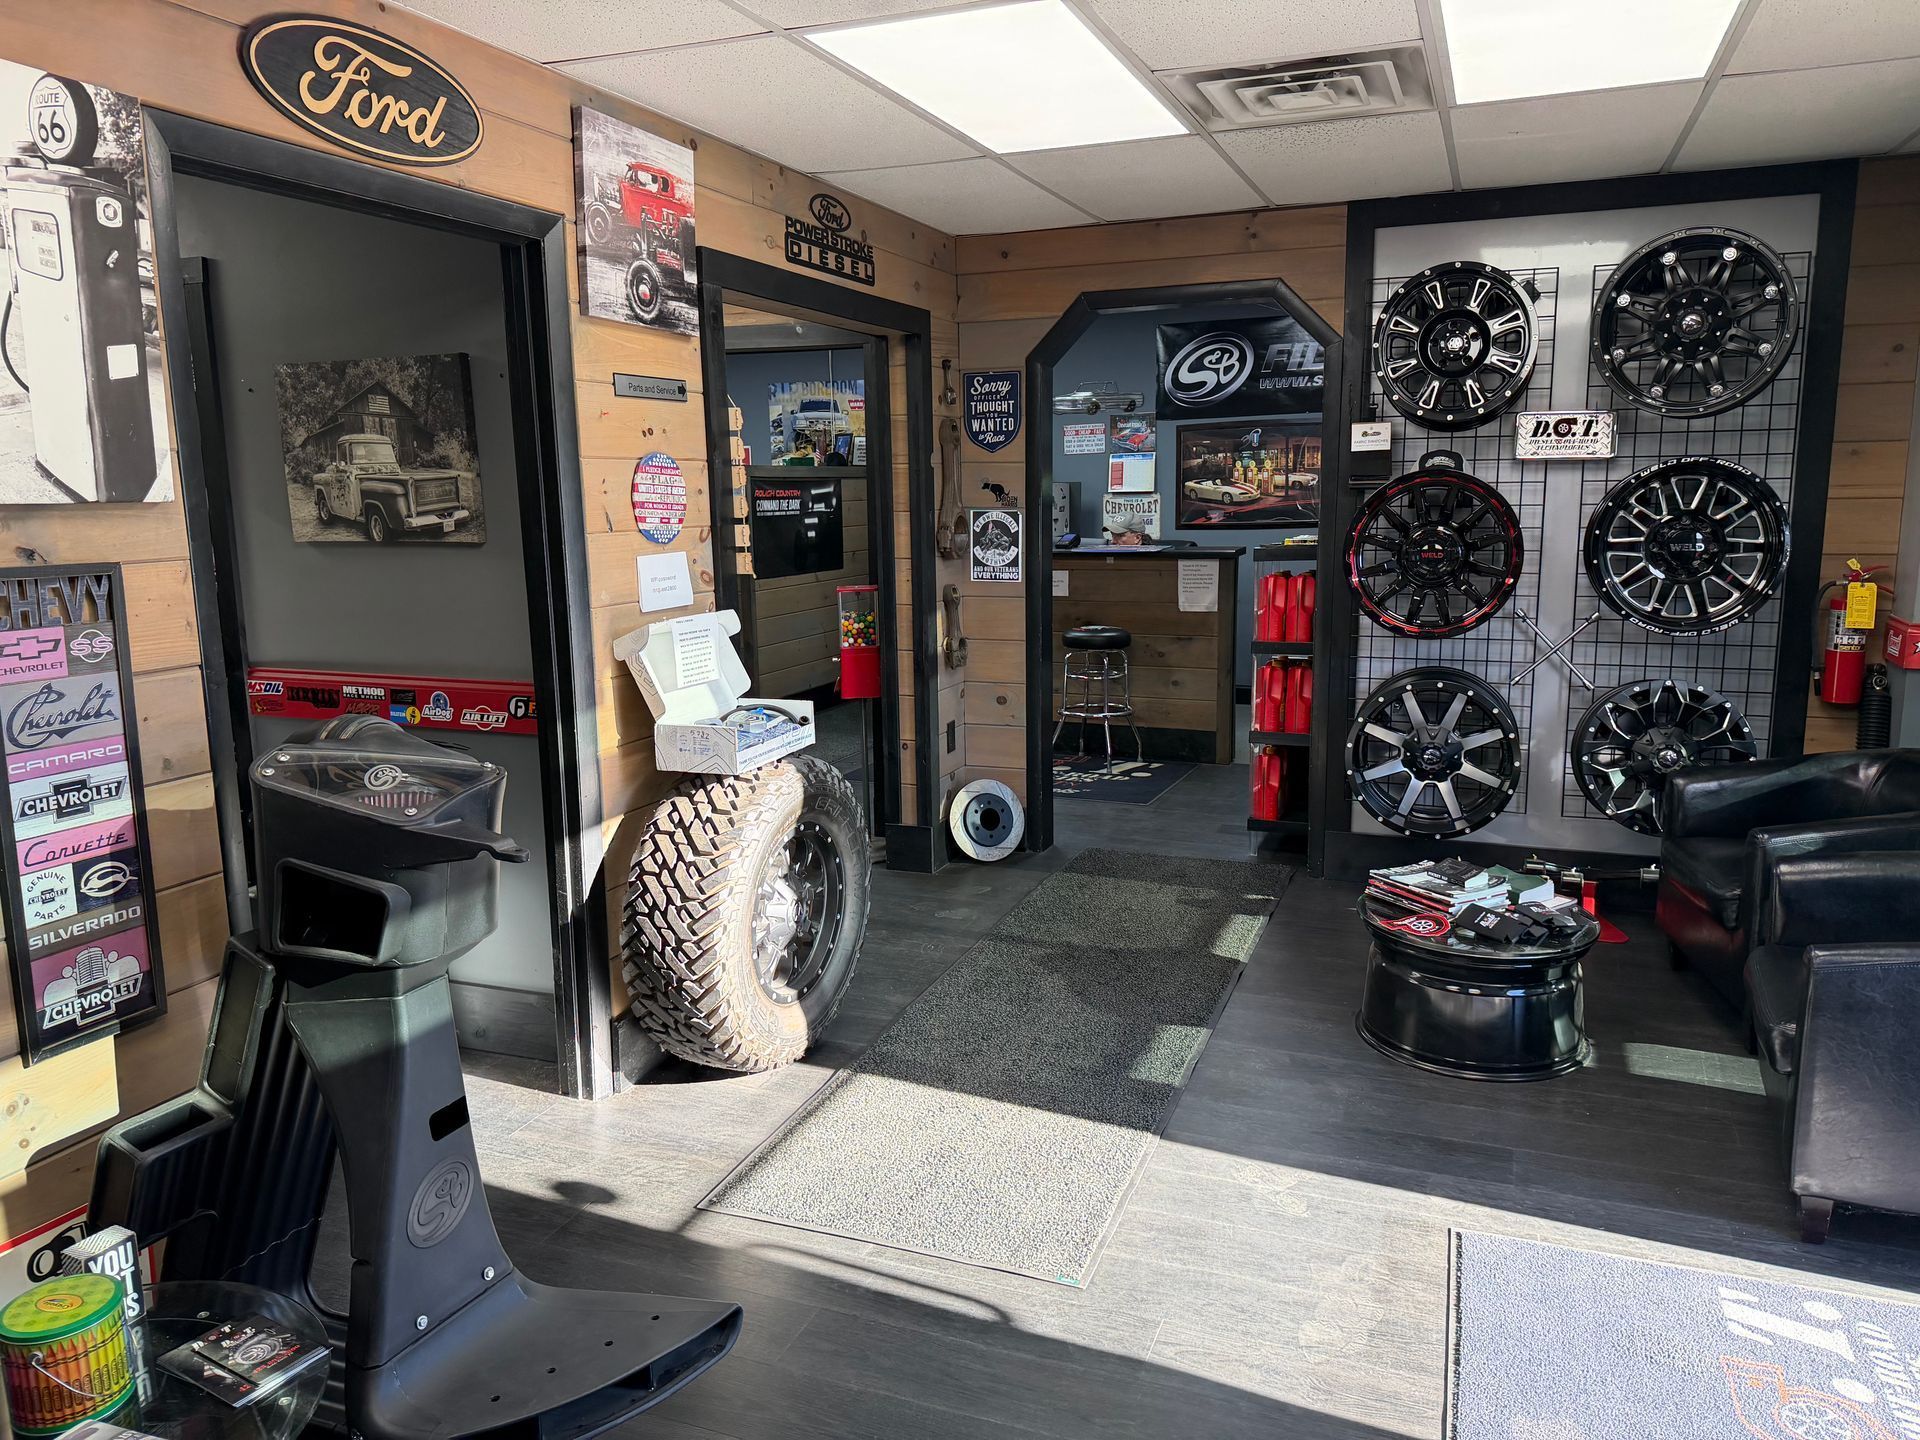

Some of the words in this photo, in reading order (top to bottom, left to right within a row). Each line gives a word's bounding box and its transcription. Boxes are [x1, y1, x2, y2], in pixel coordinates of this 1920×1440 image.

[35, 92, 60, 104] ROUTE
[299, 35, 447, 149] Ford
[37, 110, 66, 143] 66
[818, 198, 844, 229] Ford
[789, 239, 873, 280] DIESEL
[1178, 342, 1240, 393] S&B
[628, 382, 643, 393] Parts
[645, 385, 655, 393] and
[655, 385, 677, 396] Service
[970, 376, 1012, 396] Sorry
[970, 400, 1014, 415] THOUGHT
[971, 417, 1014, 432] WANTED
[983, 432, 1006, 444] Race
[1639, 459, 1678, 477] WELD
[1680, 457, 1752, 476] OFF-ROAD
[651, 474, 675, 485] FLAG
[754, 489, 775, 497] ROUGH
[775, 489, 801, 497] COUNTRY
[1104, 499, 1159, 515] CHEVROLET
[1669, 543, 1705, 551] WELD
[973, 571, 1019, 580] EVERYTHING
[70, 636, 114, 656] SS
[247, 680, 284, 695] MSOIL
[343, 685, 385, 696] METHOD
[6, 682, 120, 749] Chevrolet
[423, 707, 453, 720] AirDog
[463, 713, 481, 721] AIR
[483, 714, 505, 723] LIFT
[9, 744, 123, 775] CAMARO
[23, 781, 119, 815] CHEVROLET
[24, 831, 128, 868] Corvette
[26, 871, 67, 893] GENUINE
[34, 903, 66, 920] PARTS
[29, 905, 141, 951] SILVERADO
[53, 980, 137, 1021] CHEVROLET
[87, 1241, 134, 1276] YOU
